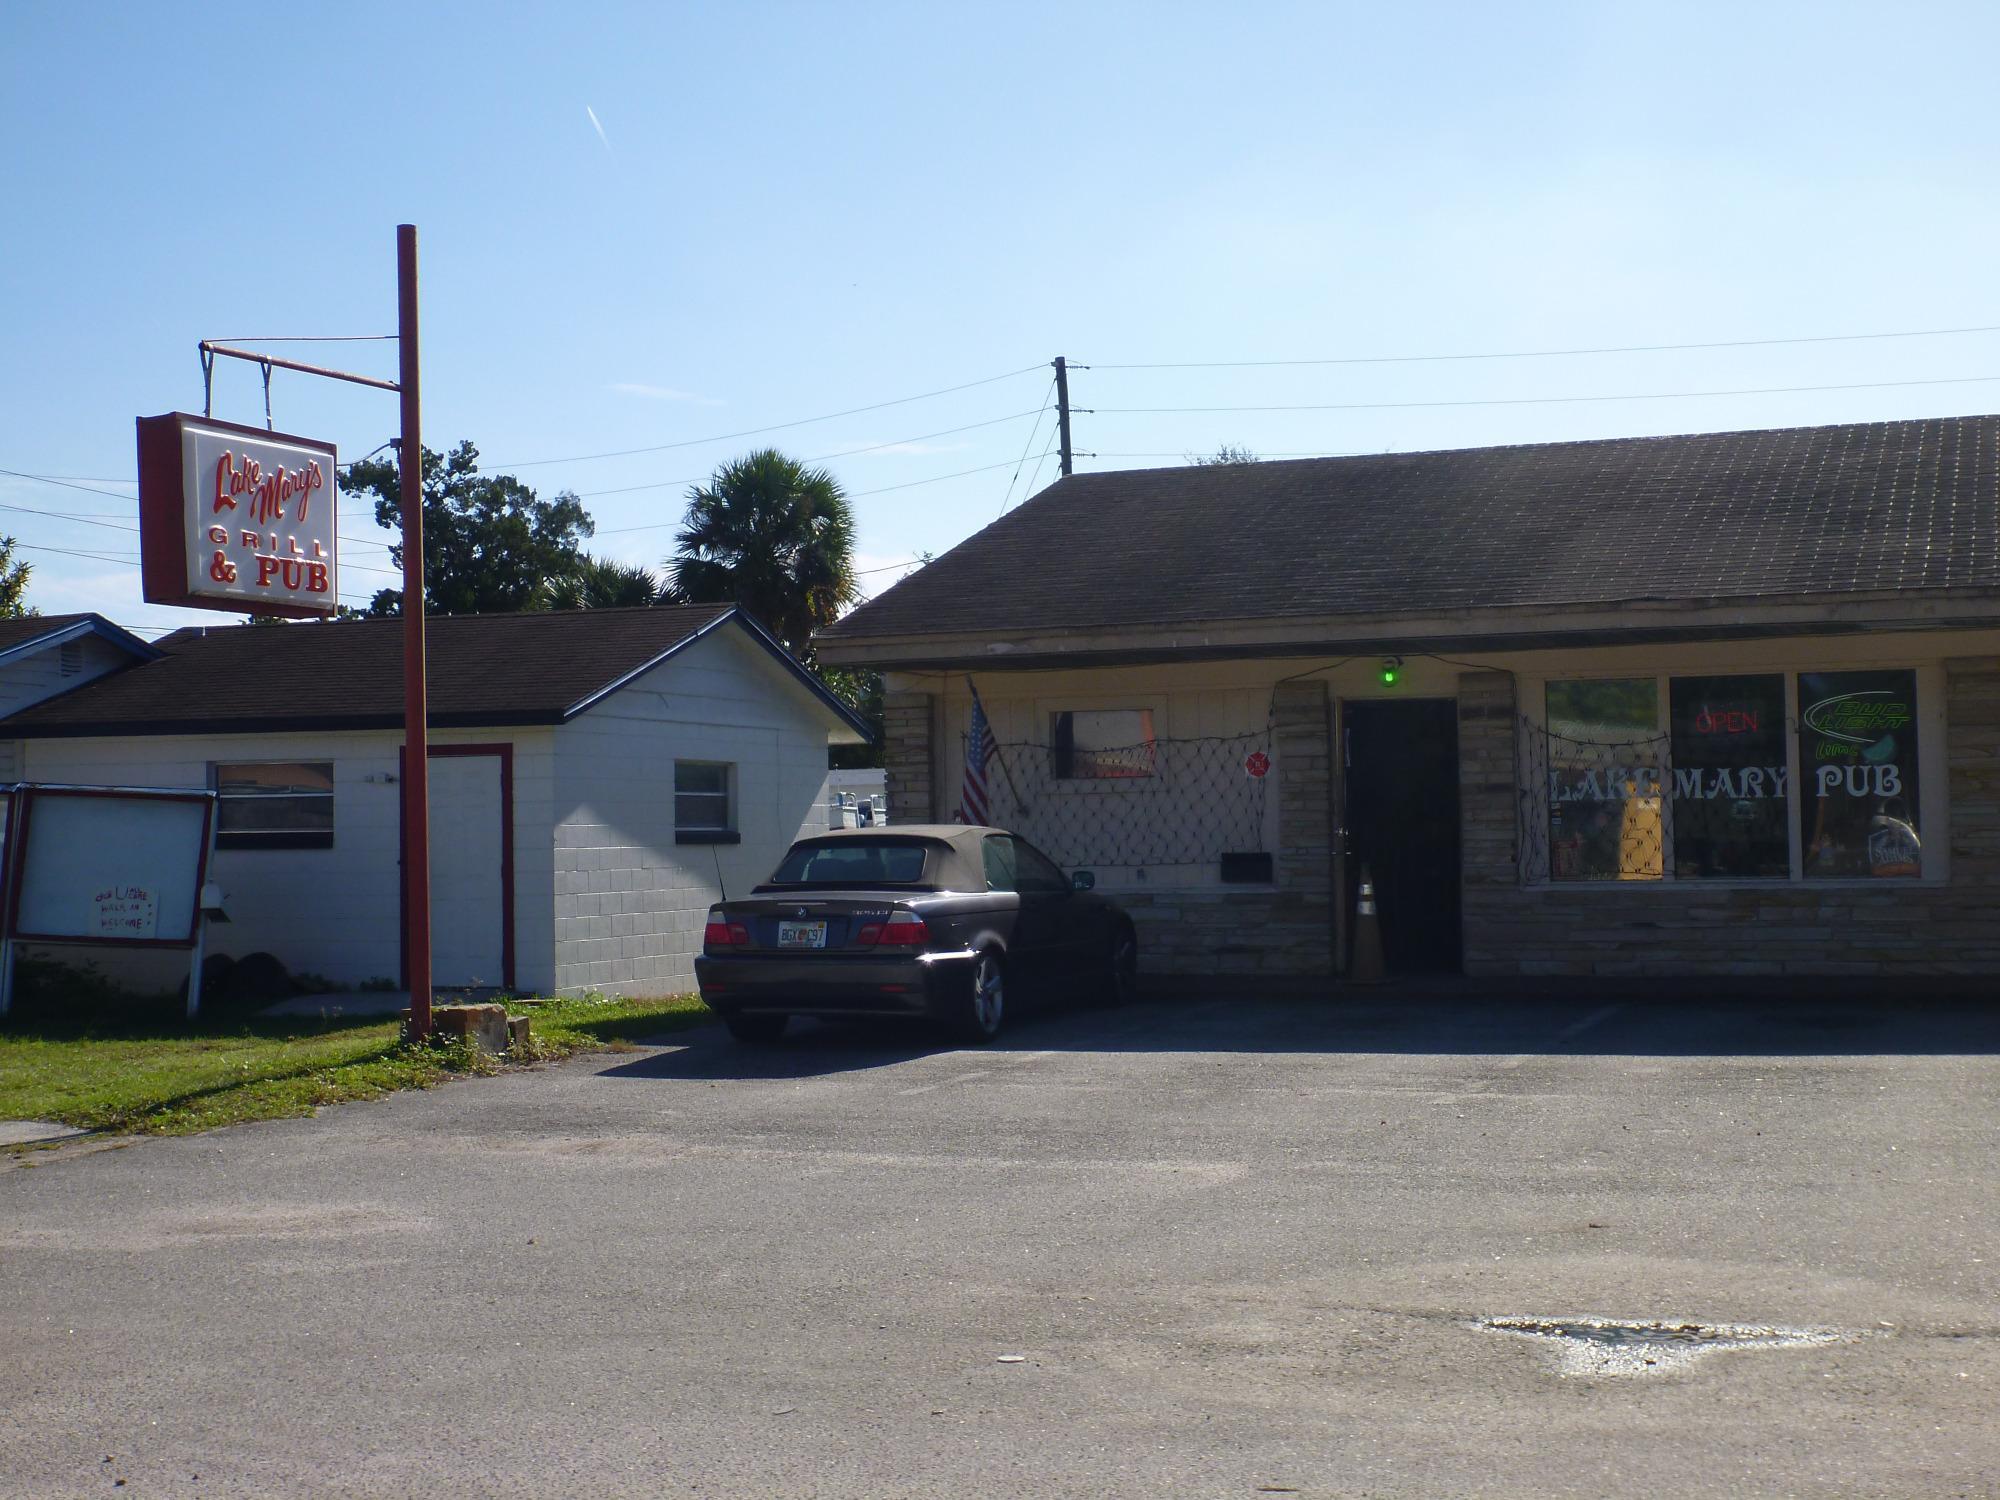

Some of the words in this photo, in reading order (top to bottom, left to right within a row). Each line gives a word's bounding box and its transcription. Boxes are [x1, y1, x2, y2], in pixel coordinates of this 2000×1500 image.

[213, 449, 264, 514] Lake
[249, 458, 324, 525] Mary's
[208, 525, 329, 558] GRILL
[209, 550, 237, 584] &
[254, 552, 329, 593] PUB
[1695, 710, 1760, 735] OPEN
[1817, 714, 1912, 730] LIGHT
[1834, 700, 1908, 716] BUD
[1548, 766, 1661, 801] LAKE
[1672, 766, 1788, 800] MARY
[1815, 763, 1902, 798] PUB
